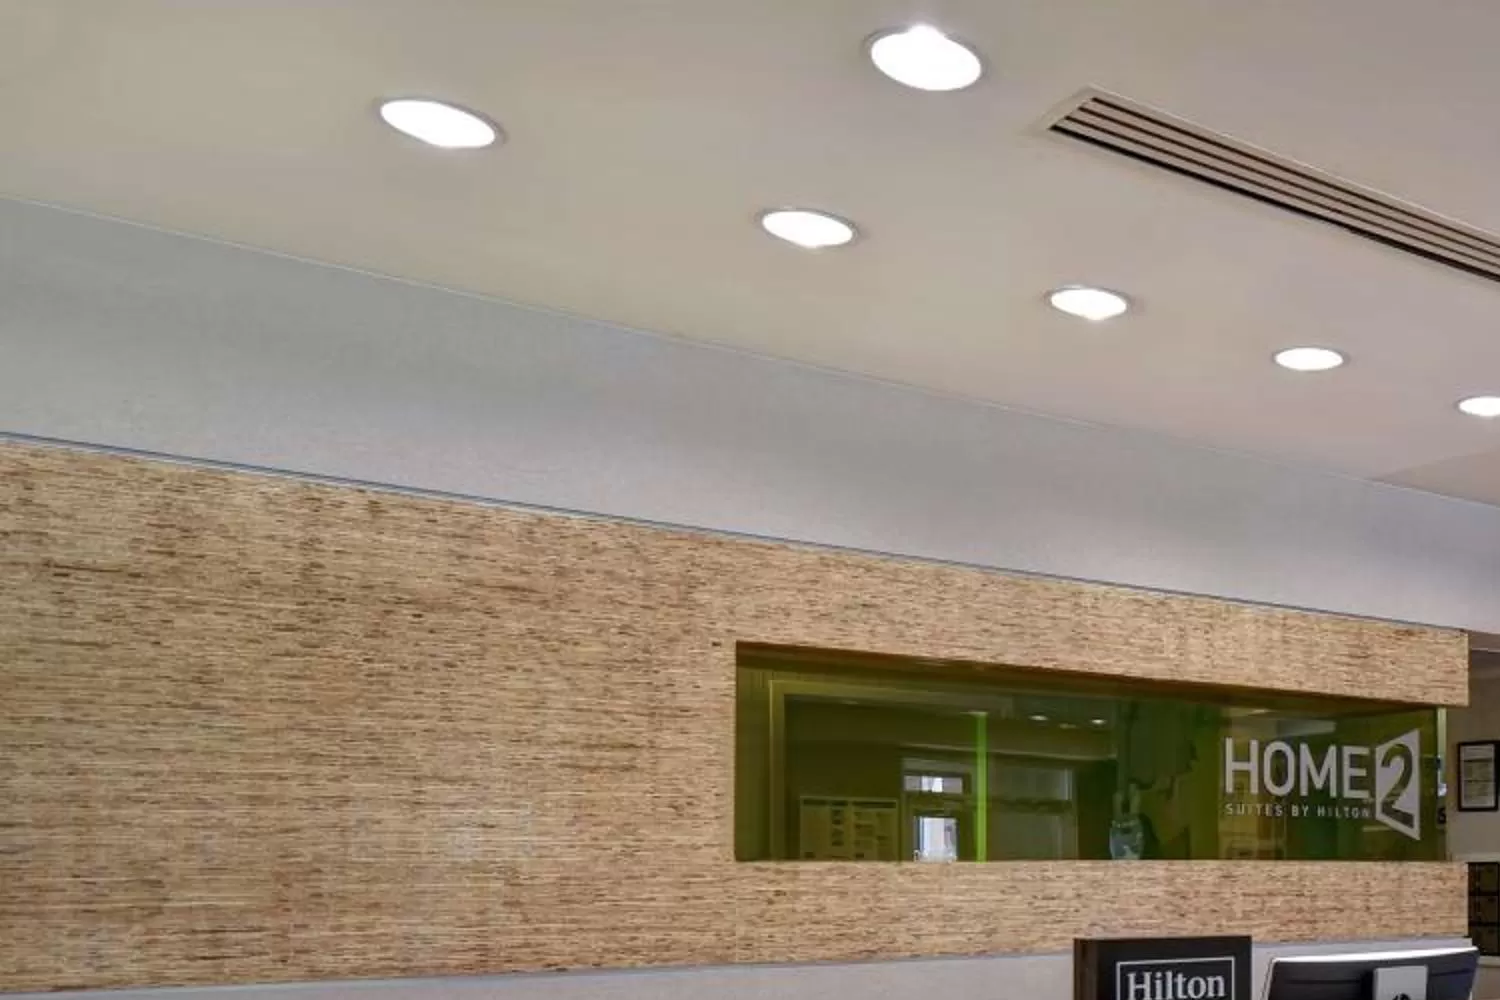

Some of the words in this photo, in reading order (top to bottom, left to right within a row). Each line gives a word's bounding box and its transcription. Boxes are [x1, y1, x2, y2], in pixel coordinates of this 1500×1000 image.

[1225, 803, 1283, 817] SUITES
[1291, 804, 1310, 817] BY
[1317, 804, 1369, 819] HILTON
